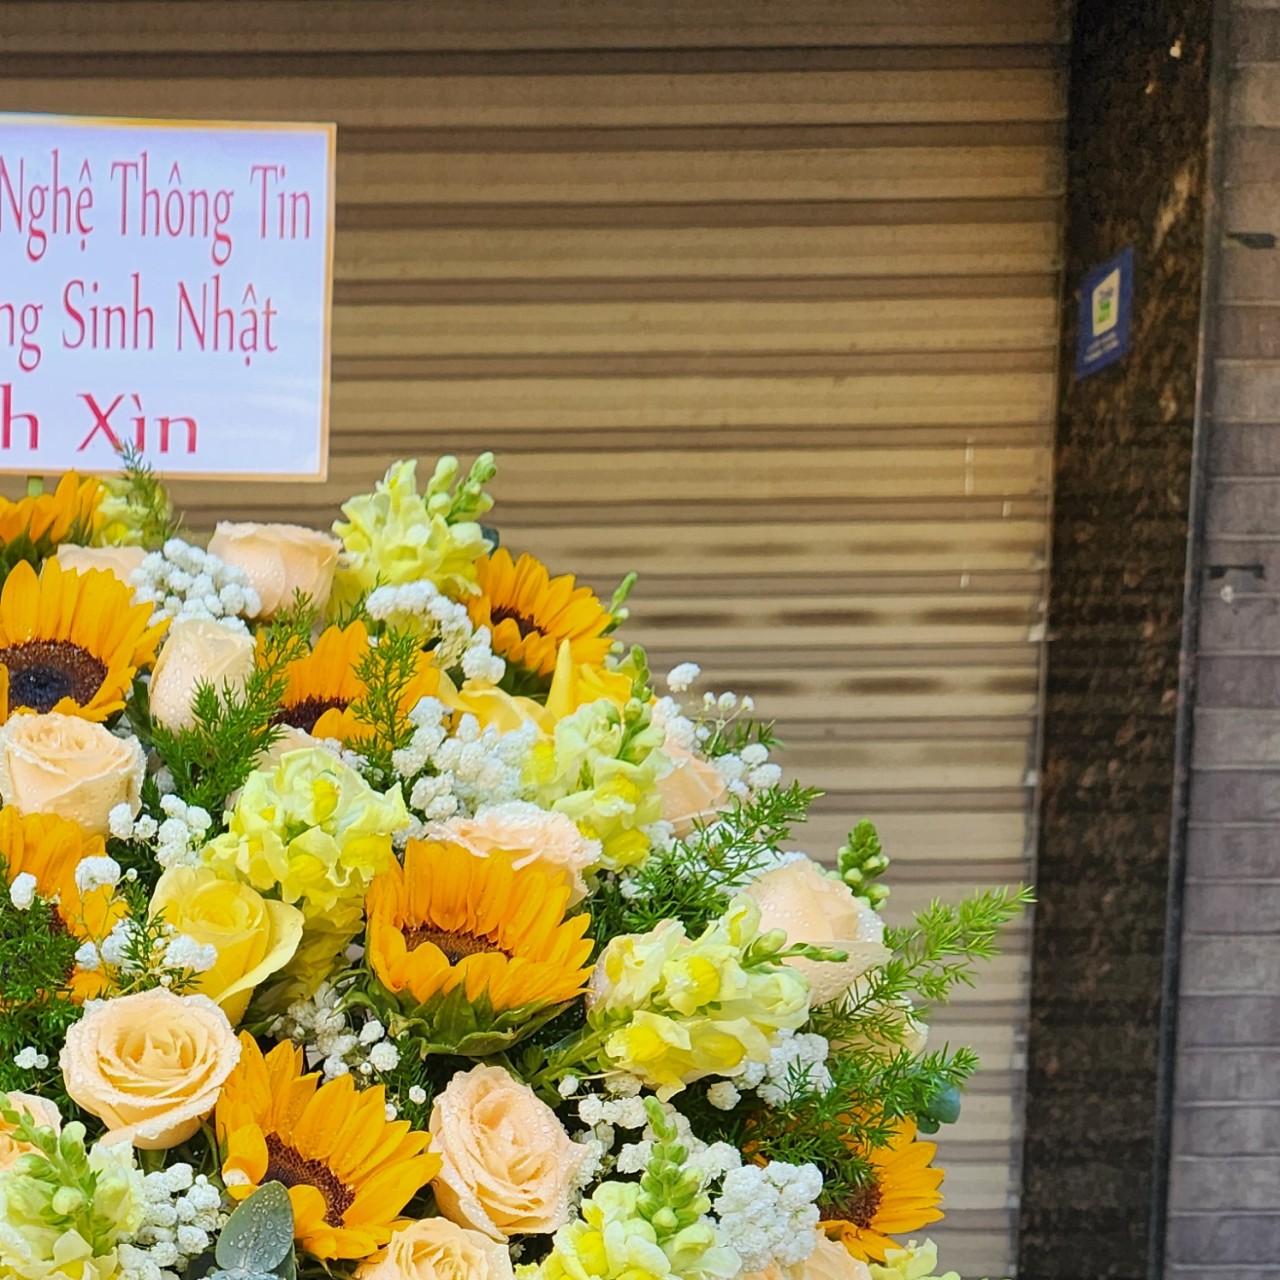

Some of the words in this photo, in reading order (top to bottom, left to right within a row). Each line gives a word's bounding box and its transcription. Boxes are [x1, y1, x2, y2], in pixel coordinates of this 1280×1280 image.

[112, 152, 233, 267] Thông
[250, 164, 311, 239] Tin
[63, 273, 154, 349] Sinh
[177, 274, 278, 366] Nhật
[78, 393, 197, 454] Xìn
